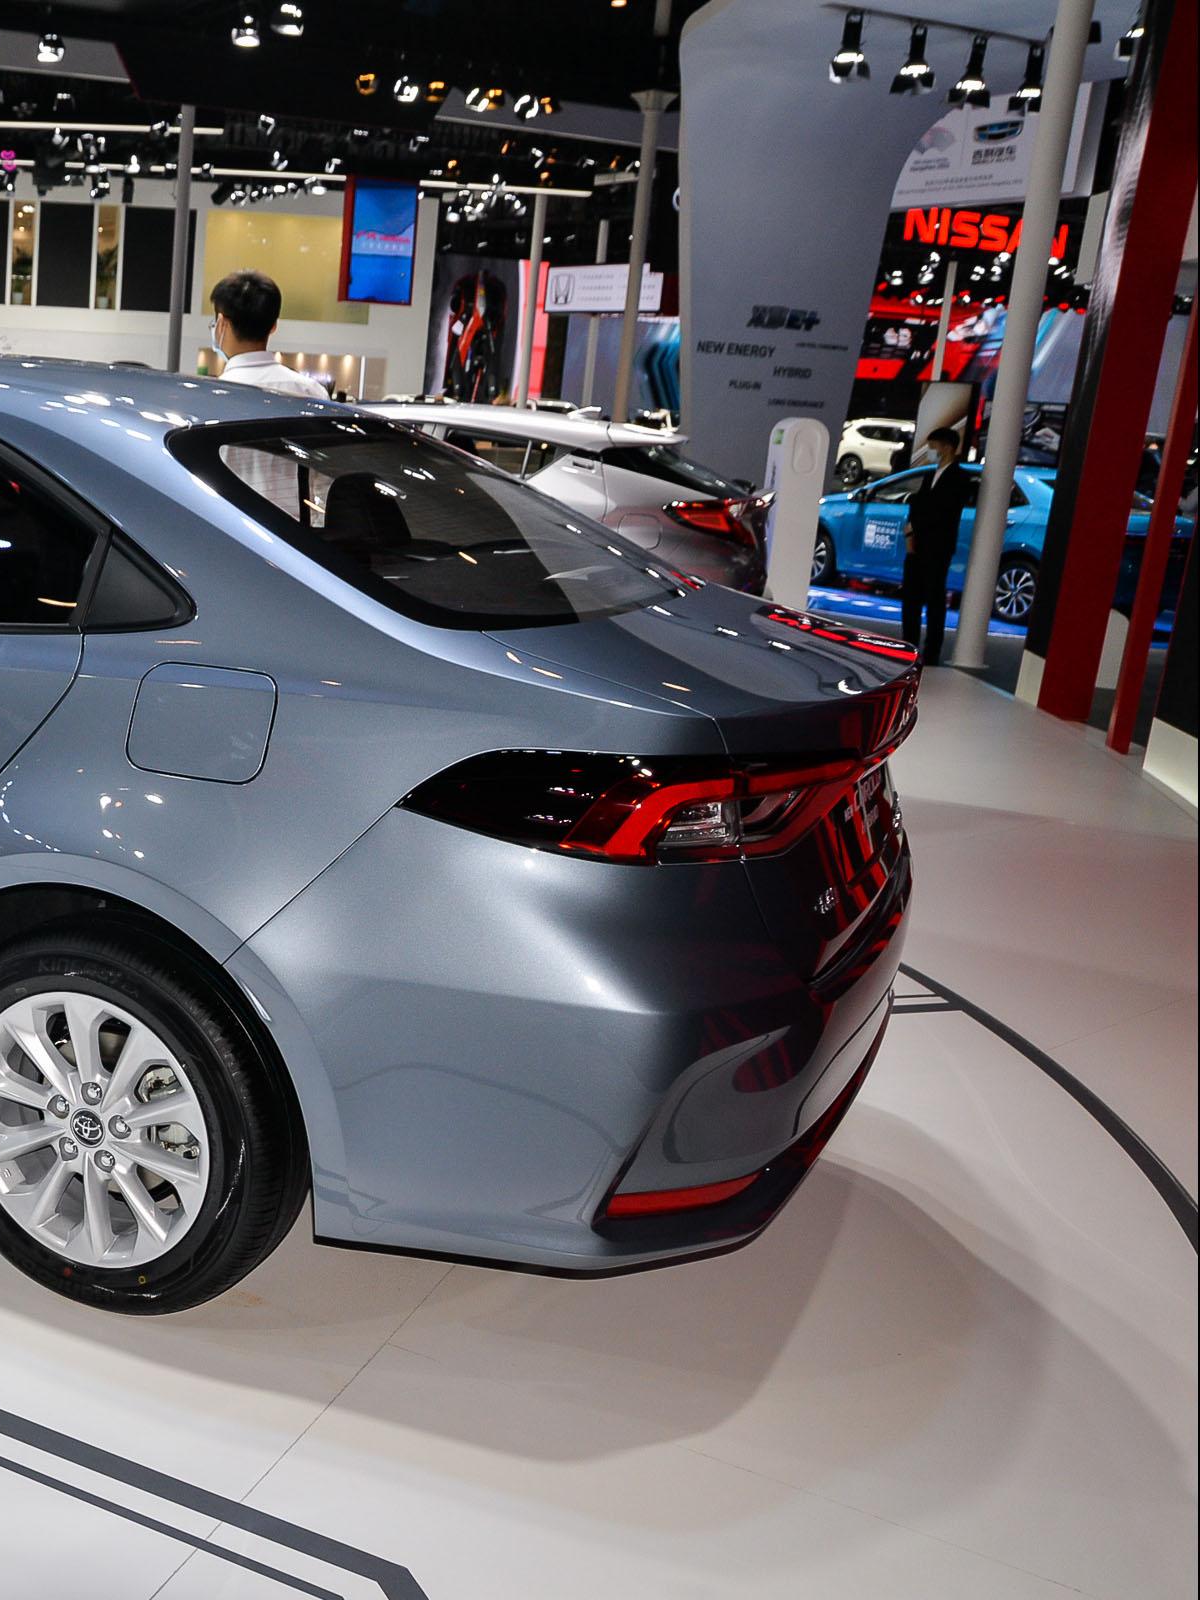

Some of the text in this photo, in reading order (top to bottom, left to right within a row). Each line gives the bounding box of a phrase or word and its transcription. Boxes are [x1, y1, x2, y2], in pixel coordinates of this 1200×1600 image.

[697, 340, 725, 355] NEW
[727, 342, 776, 358] ENERGY
[773, 366, 812, 379] HYBRID
[729, 379, 762, 390] PLUG-IN
